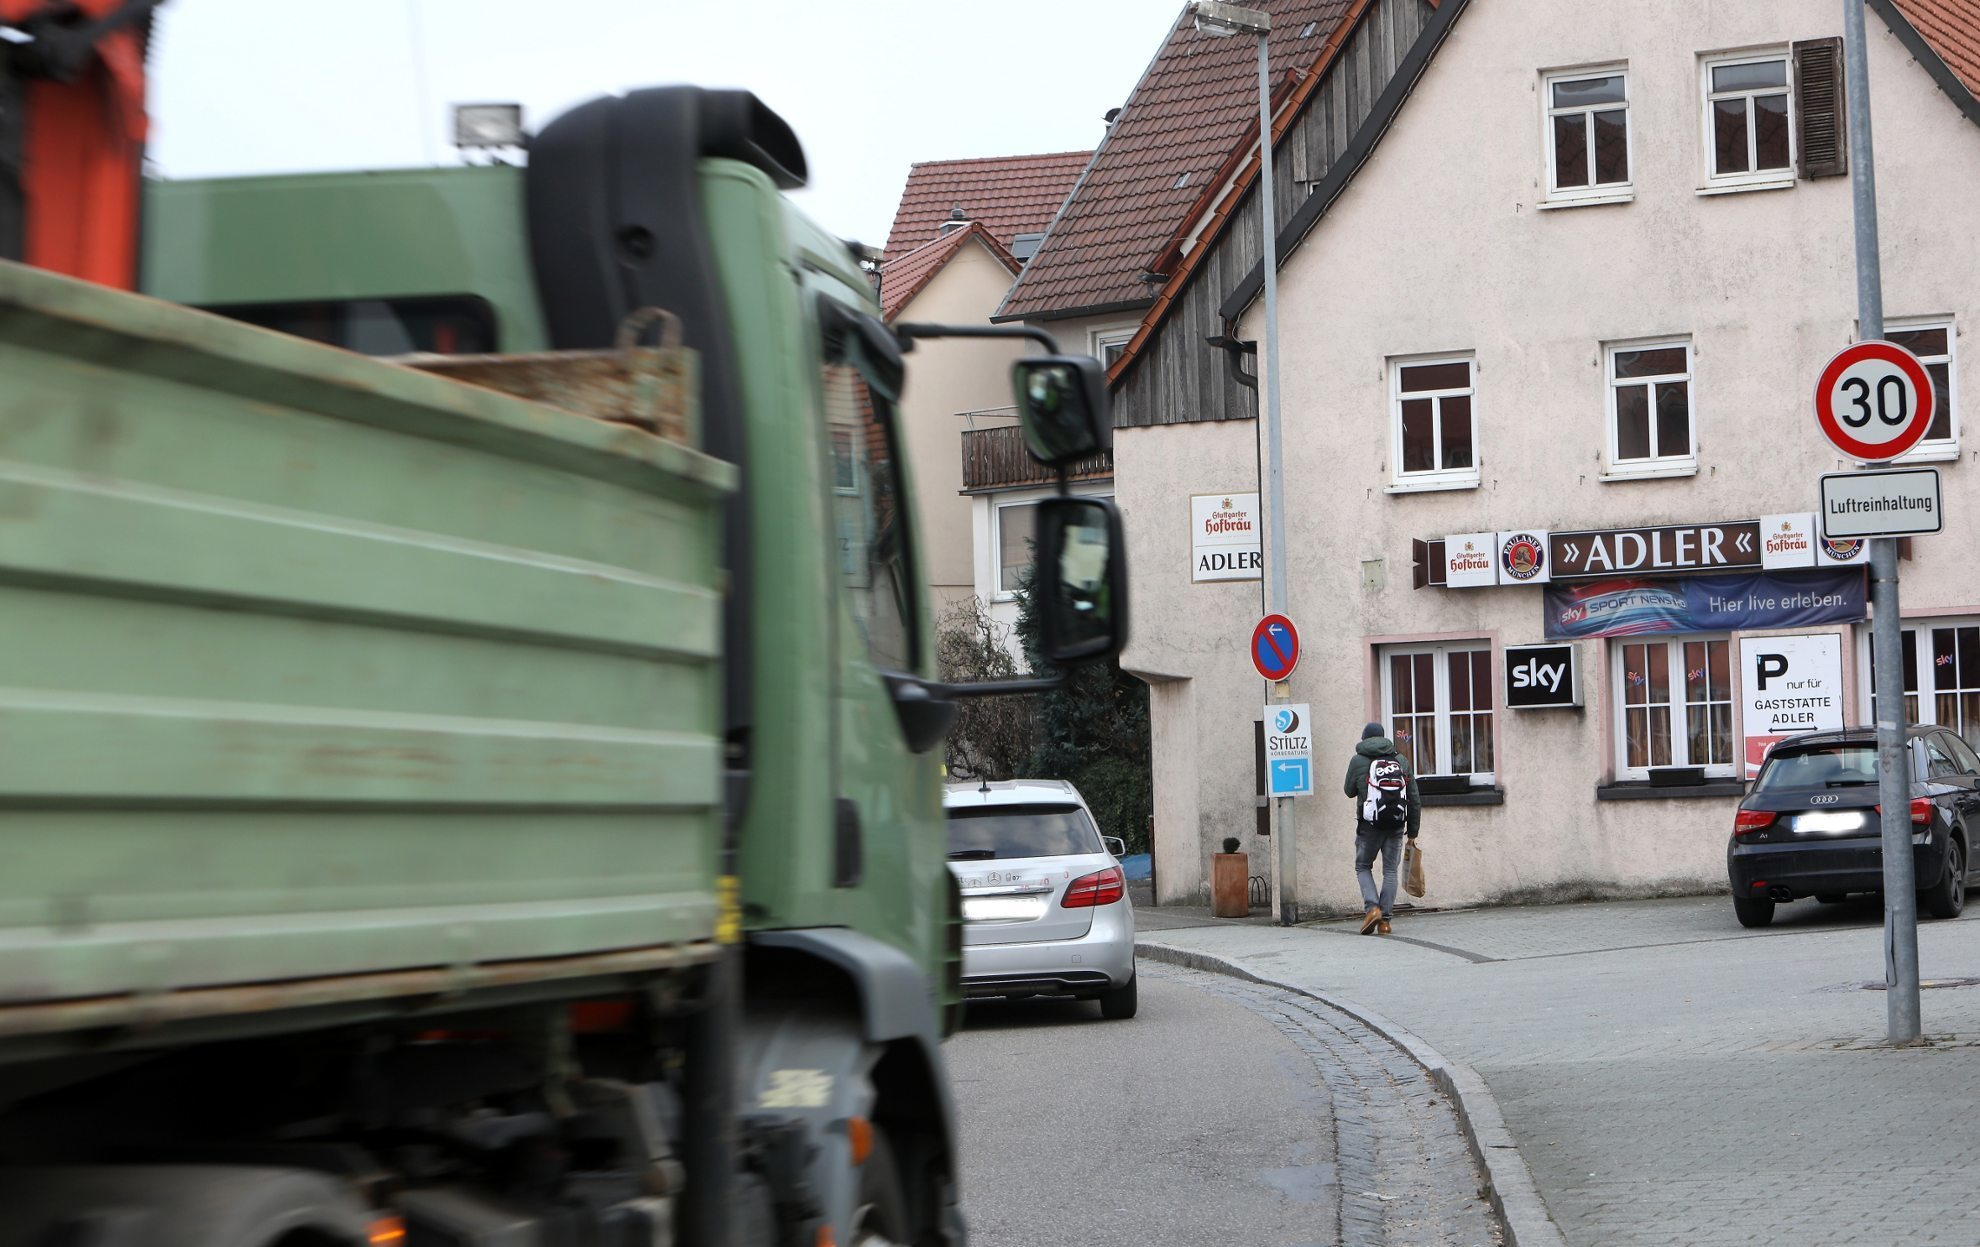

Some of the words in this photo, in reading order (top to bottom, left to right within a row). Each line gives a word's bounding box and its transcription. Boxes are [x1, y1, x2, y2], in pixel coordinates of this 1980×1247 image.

[1841, 375, 1907, 428] 30
[1830, 495, 1932, 514] Luftreinhaltung
[1212, 511, 1247, 520] Stuttgarter
[1205, 518, 1251, 535] Hofbräu
[1772, 532, 1803, 540] Stuttgarter
[1503, 535, 1542, 554] PAULANER
[1583, 527, 1728, 572] ADLER
[1766, 538, 1807, 553] Hofbräu
[1199, 552, 1262, 571] ADLER
[1456, 552, 1486, 560] Stuttgarter
[1450, 557, 1489, 572] Hofbräu
[1561, 607, 1583, 623] sky
[1589, 595, 1636, 613] SPORT
[1640, 595, 1672, 605] NEWS
[1710, 596, 1743, 612] Hier
[1748, 594, 1775, 611] live
[1781, 591, 1847, 609] erleben.
[1936, 654, 1953, 666] sky
[1512, 657, 1566, 693] sky
[1687, 667, 1704, 681] sky
[1756, 653, 1789, 691] P
[1786, 681, 1805, 690] nur
[1807, 679, 1822, 689] für
[1754, 696, 1831, 710] GASTSTÄTTE
[1771, 712, 1815, 723] ADLER
